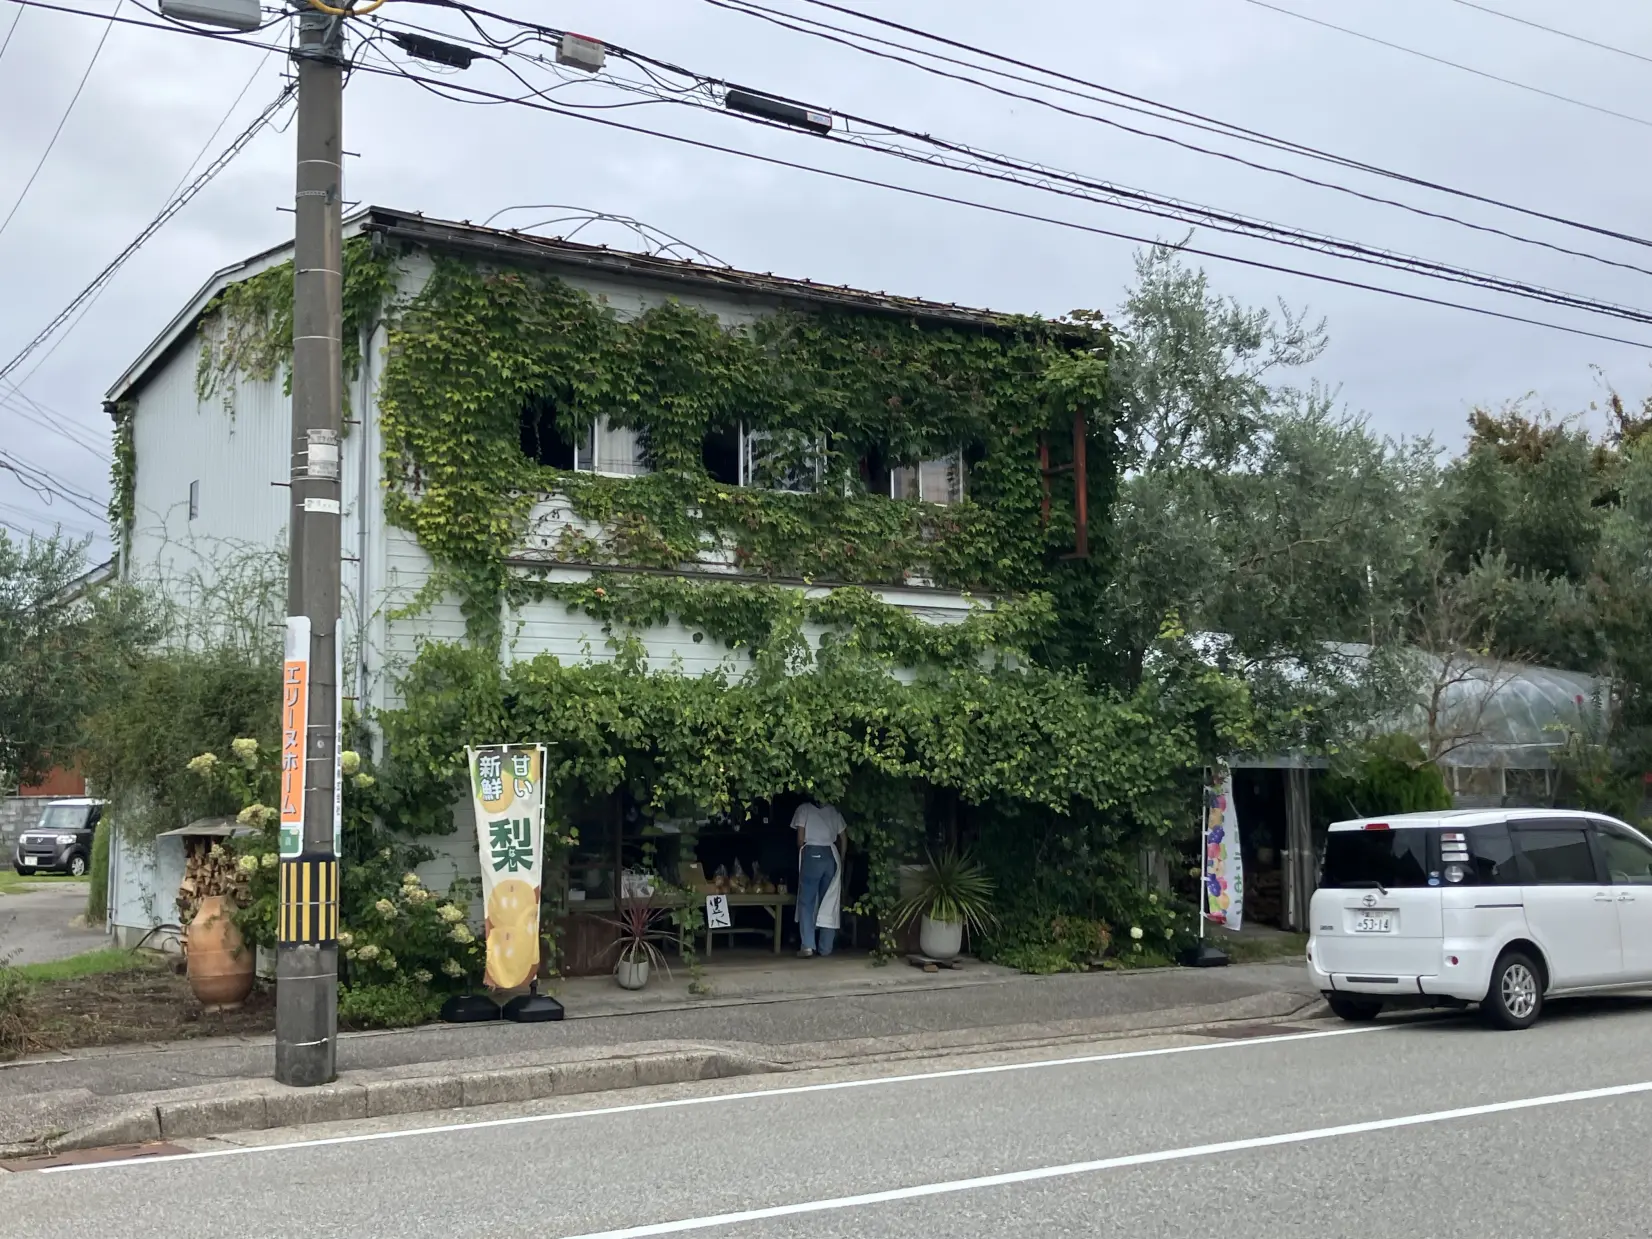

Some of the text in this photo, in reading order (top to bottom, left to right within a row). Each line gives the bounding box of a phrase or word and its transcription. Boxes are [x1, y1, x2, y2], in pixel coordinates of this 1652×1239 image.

[283, 666, 301, 814] エリーヌホーム
[479, 755, 503, 801] 新鮮
[511, 754, 533, 798] 甘い
[488, 817, 533, 872] 梨
